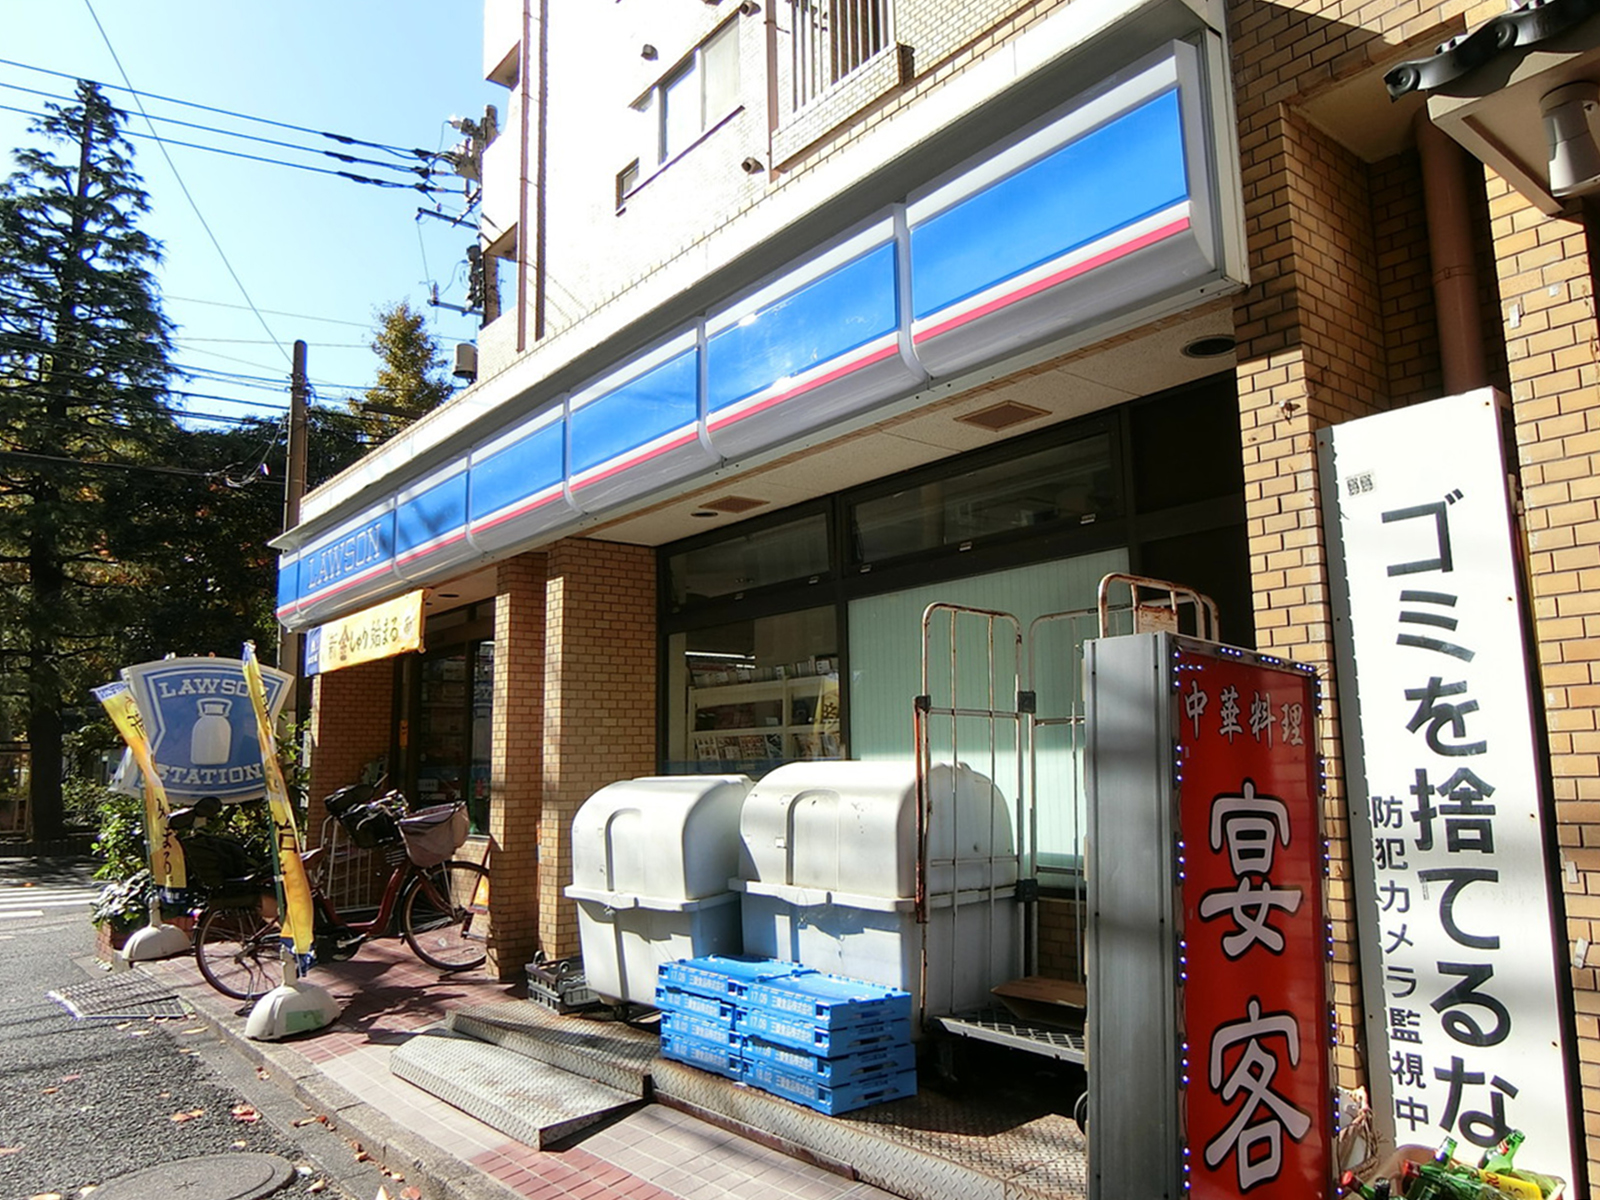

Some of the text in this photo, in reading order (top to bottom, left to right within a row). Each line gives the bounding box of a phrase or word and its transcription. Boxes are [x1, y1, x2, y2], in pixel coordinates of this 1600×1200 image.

[307, 523, 381, 589] LAWSON
[158, 677, 266, 699] LAWSO
[1184, 679, 1305, 748] 中華料理
[156, 763, 263, 786] STATION
[1381, 487, 1519, 1148] ゴミを捨てるな
[1198, 778, 1312, 1192] 宴客
[1371, 795, 1430, 1133] 防犯カメラ監視中
